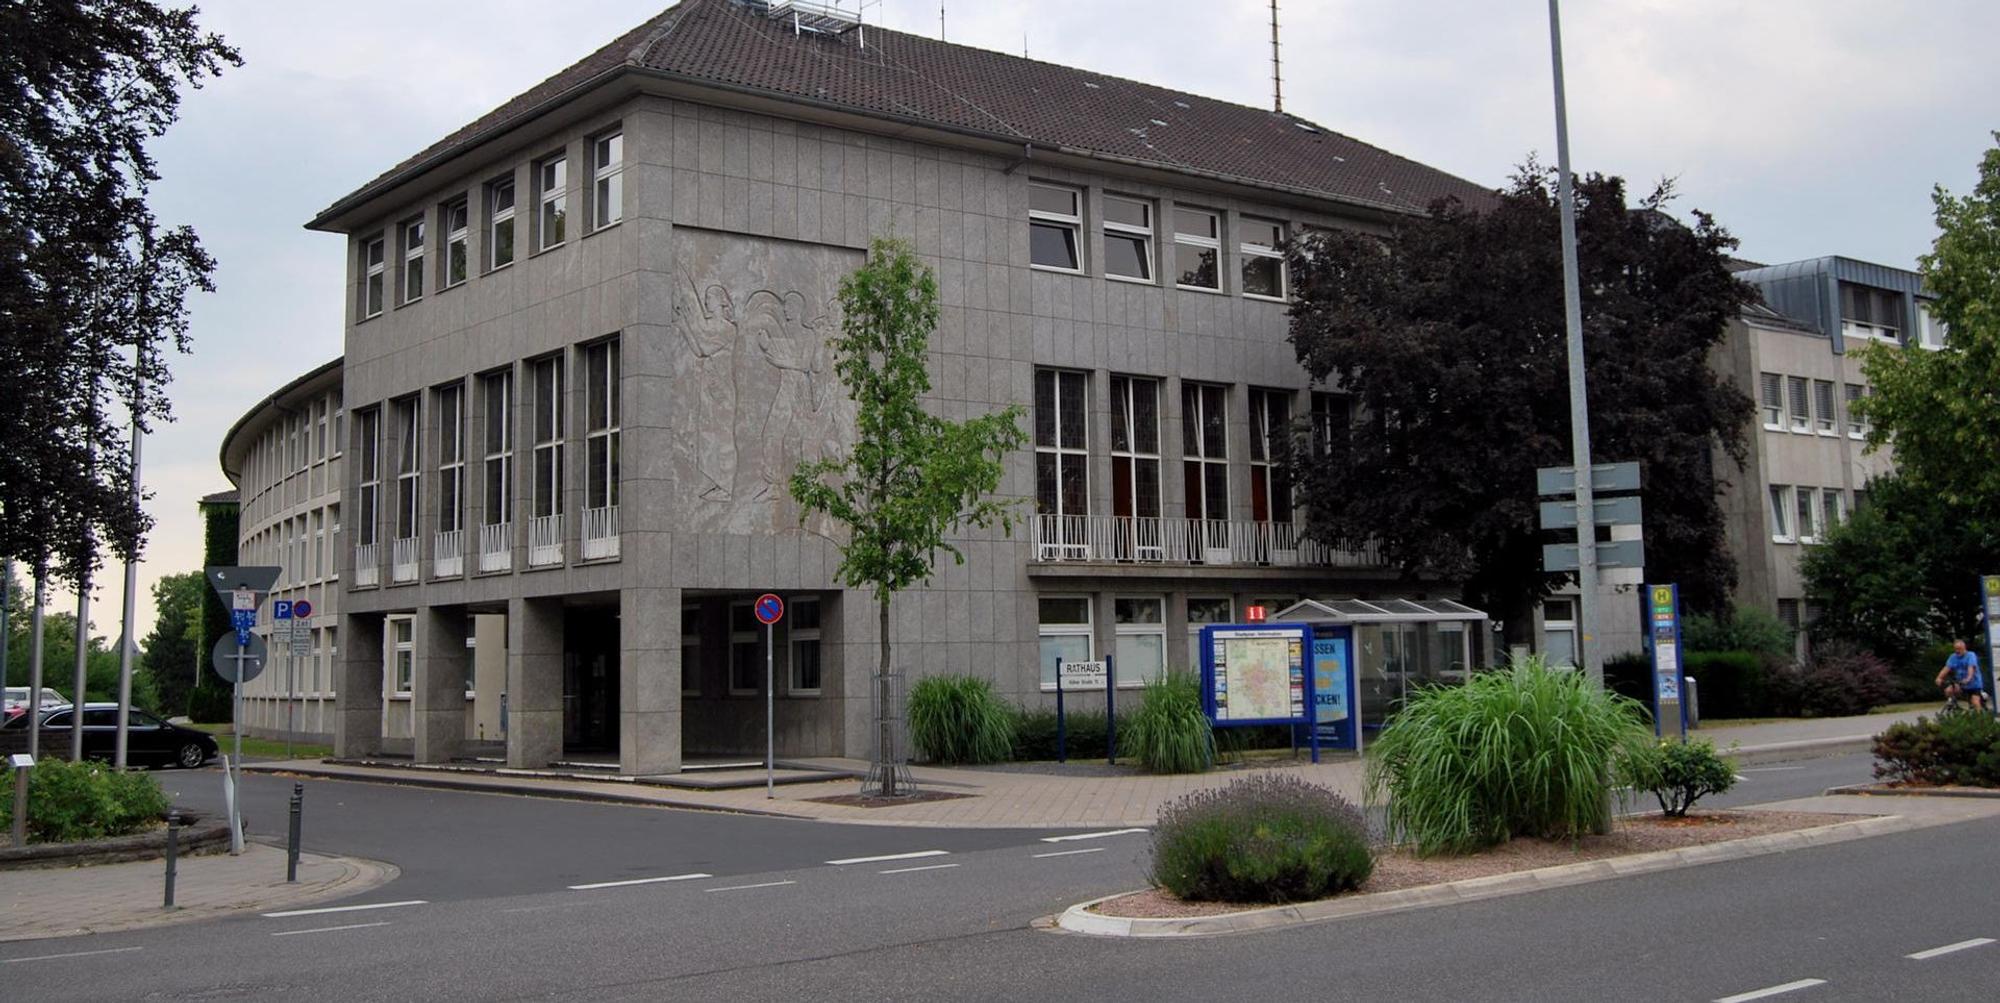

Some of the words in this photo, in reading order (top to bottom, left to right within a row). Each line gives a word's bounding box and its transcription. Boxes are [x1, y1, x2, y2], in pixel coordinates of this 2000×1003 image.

[1657, 591, 1667, 601] H
[278, 602, 289, 617] P
[1249, 606, 1264, 620] 11
[1066, 663, 1101, 673] RATHAUS
